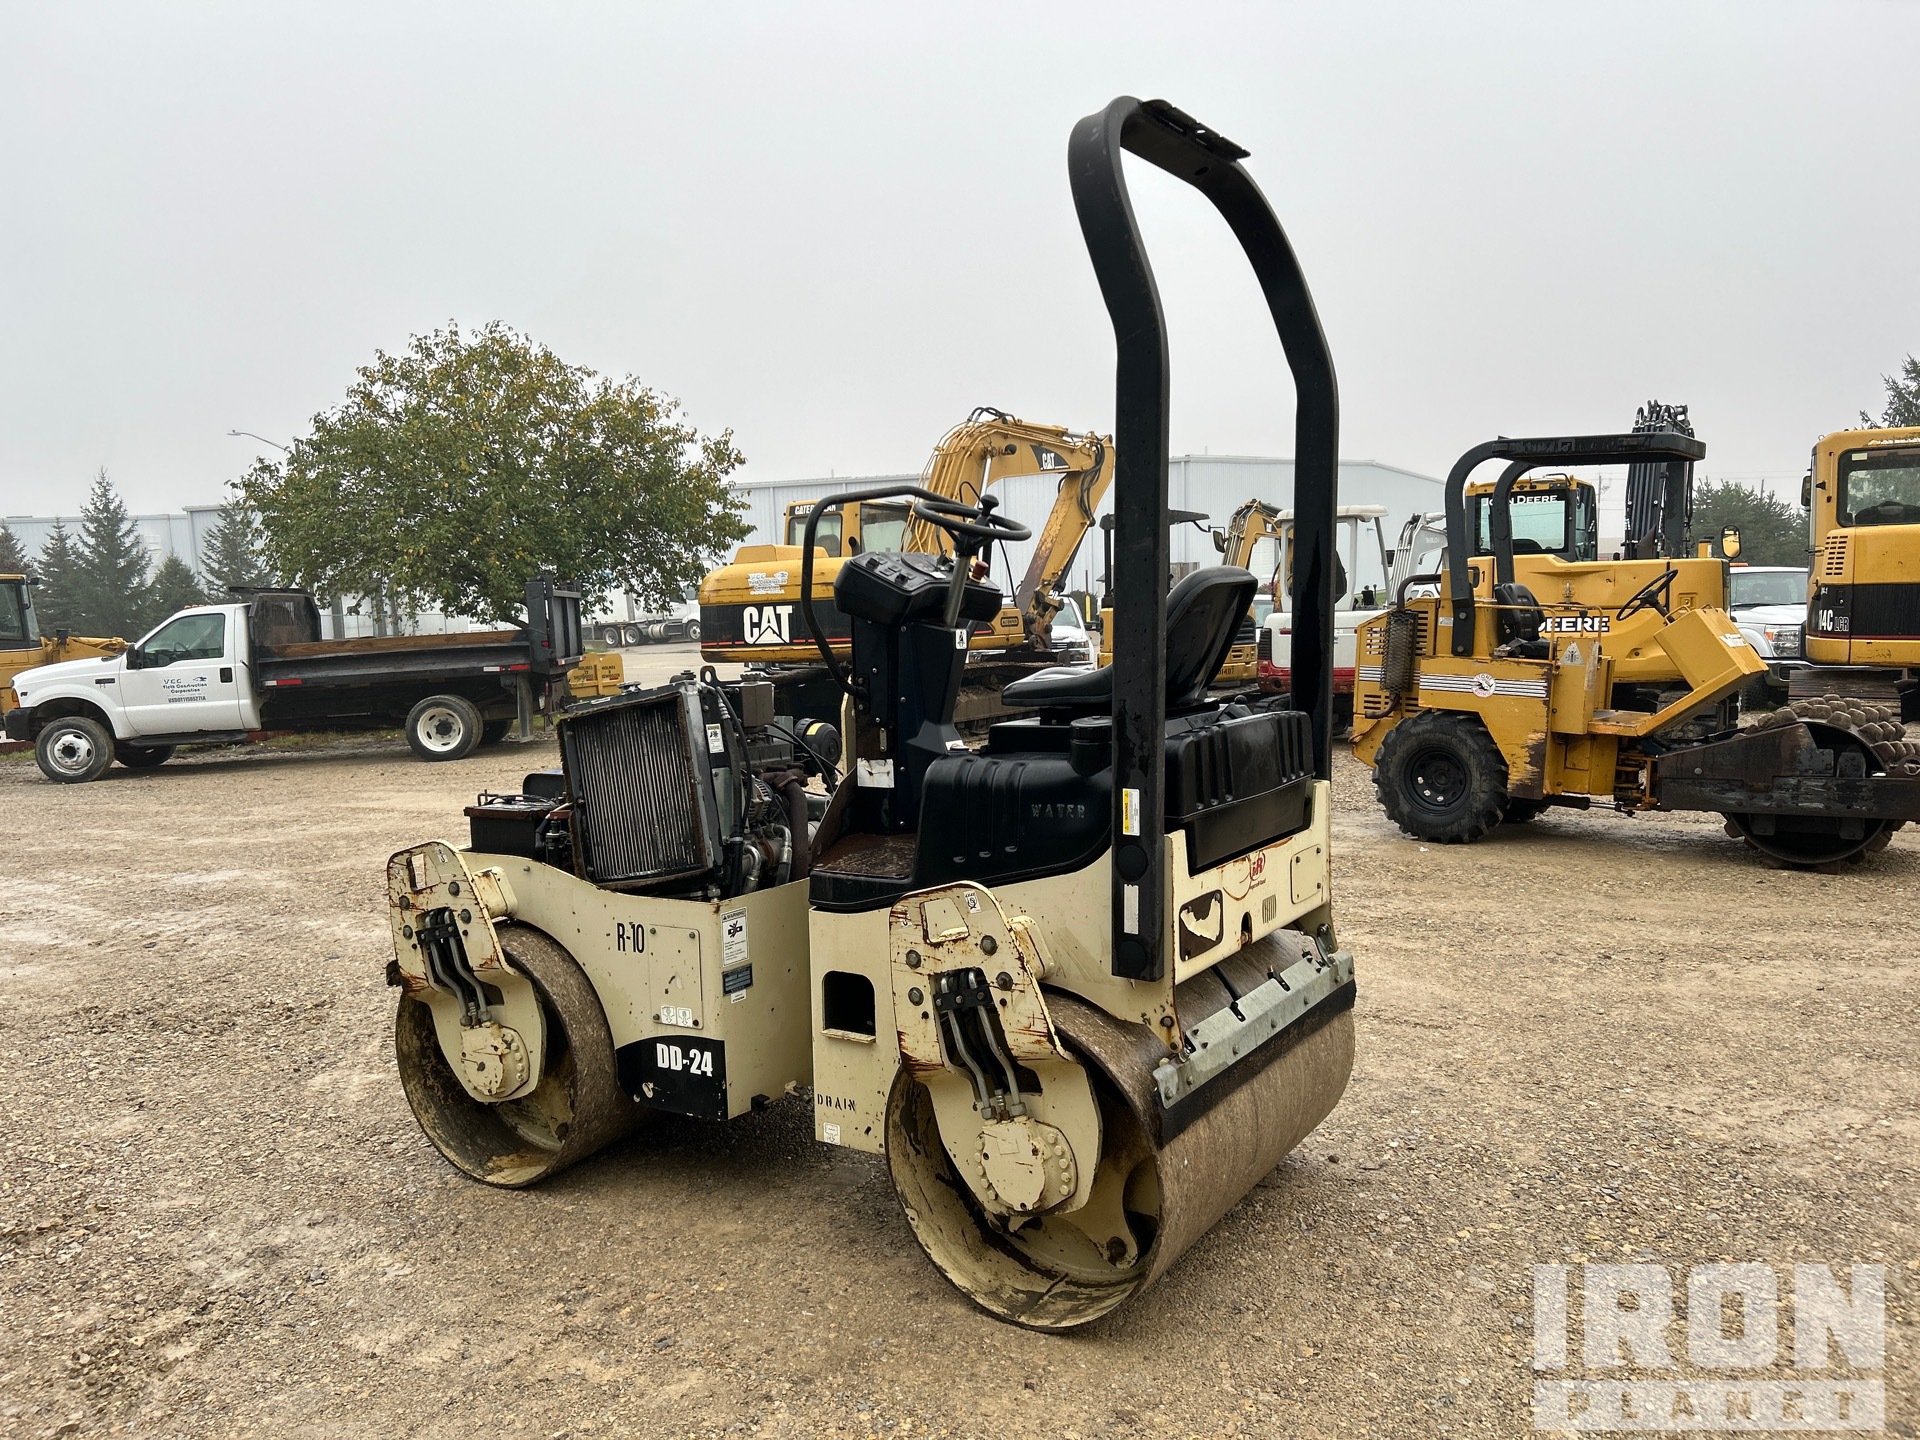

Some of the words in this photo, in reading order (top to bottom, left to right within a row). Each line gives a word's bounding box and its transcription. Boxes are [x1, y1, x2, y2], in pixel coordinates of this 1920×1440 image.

[1042, 452, 1055, 469] CAT
[1517, 495, 1557, 504] DEERE
[743, 605, 793, 645] CAT
[1031, 803, 1085, 818] WATER
[616, 922, 645, 953] R-10
[656, 1043, 713, 1077] DD-24
[817, 1093, 856, 1113] DRAIN
